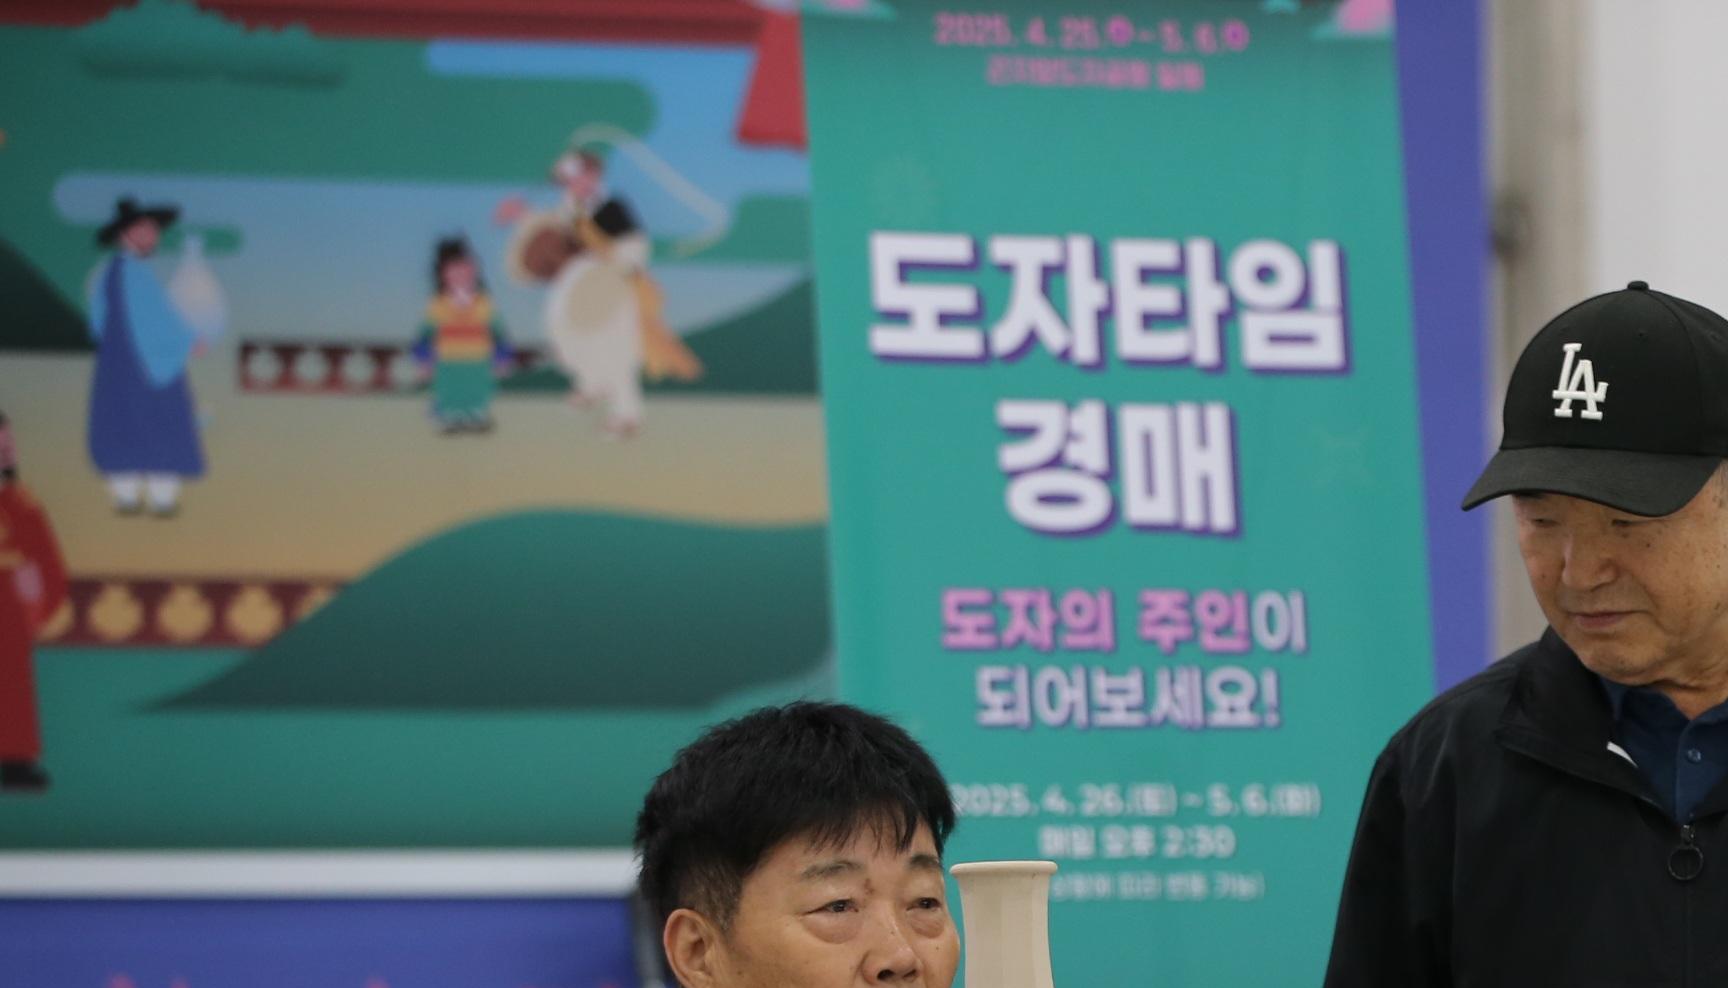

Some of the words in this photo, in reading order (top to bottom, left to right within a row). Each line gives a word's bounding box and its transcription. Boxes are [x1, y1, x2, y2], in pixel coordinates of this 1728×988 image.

[867, 231, 1352, 376] 도자타임
[1552, 342, 1609, 421] LA
[994, 398, 1242, 539] 경매
[941, 587, 1114, 653] 도자의
[1138, 588, 1309, 656] 주인이
[976, 664, 1282, 731] 되어보세요!
[1161, 824, 1237, 860] 2:30
